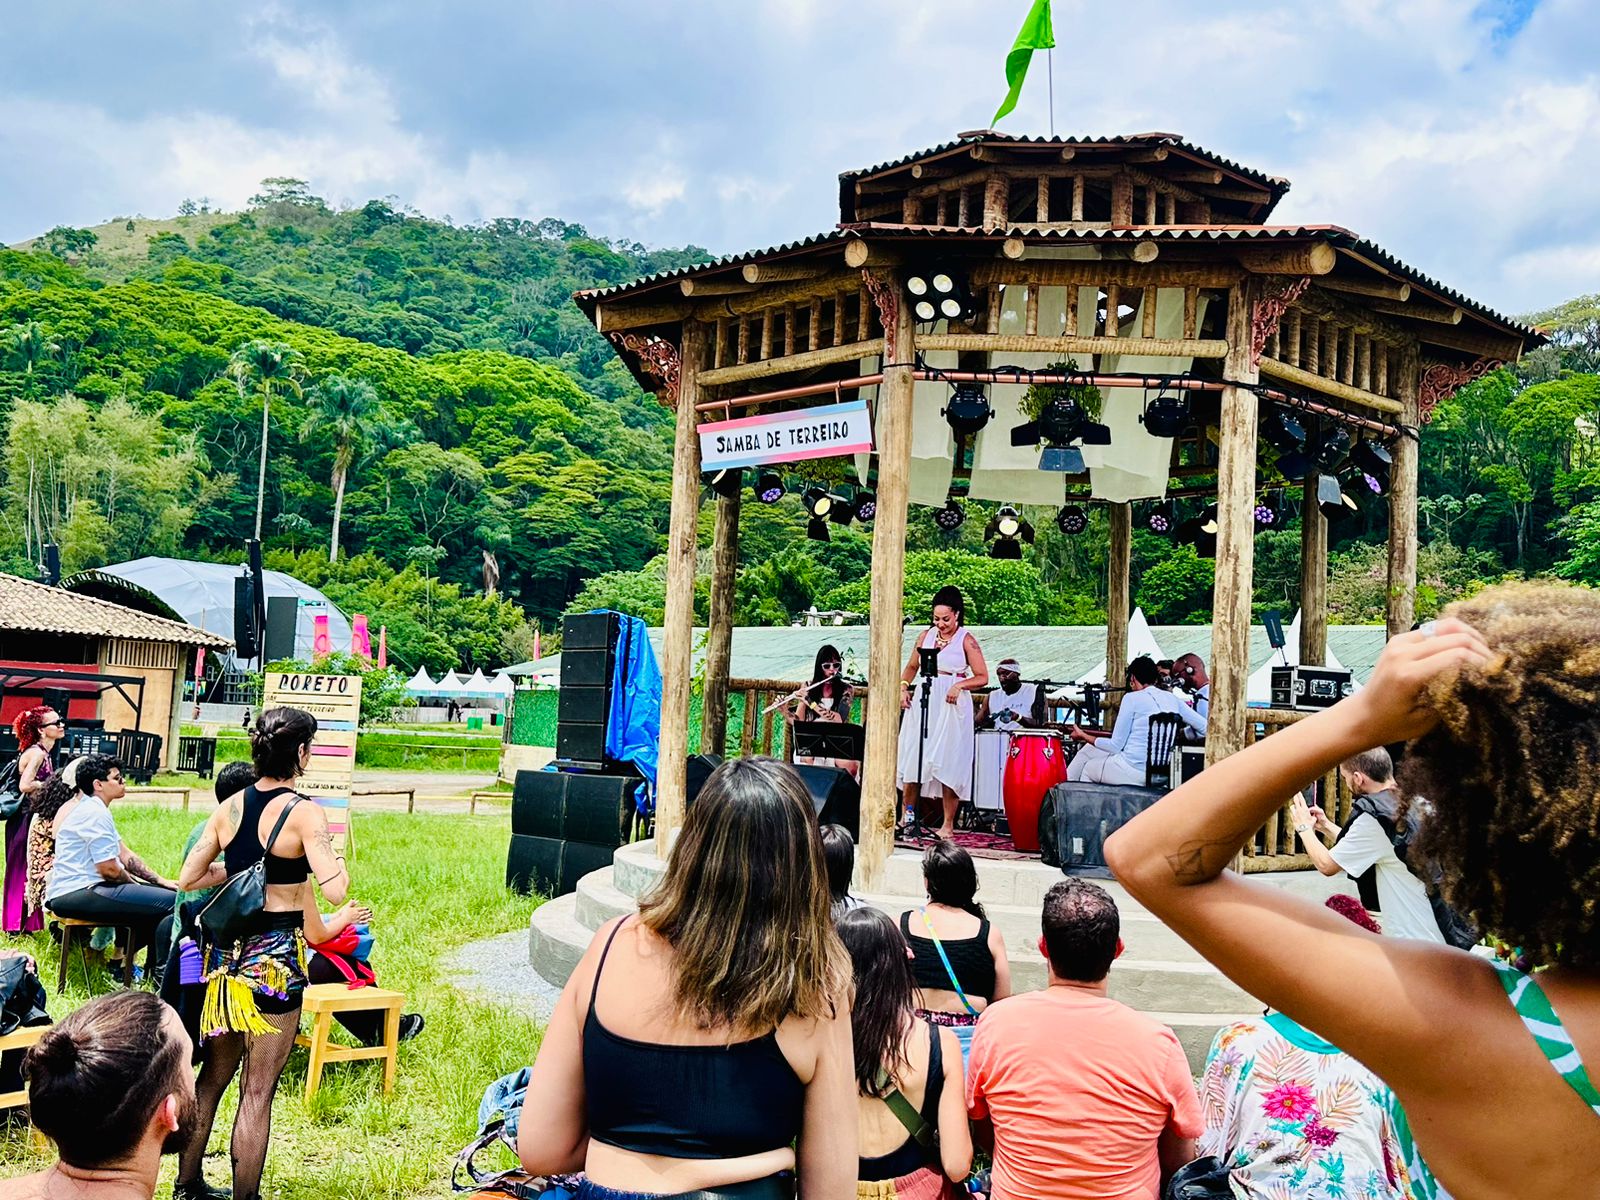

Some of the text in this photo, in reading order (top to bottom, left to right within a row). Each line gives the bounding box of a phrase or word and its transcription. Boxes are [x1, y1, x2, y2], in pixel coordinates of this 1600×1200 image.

[716, 421, 849, 453] SAMBA DE TERREIRO
